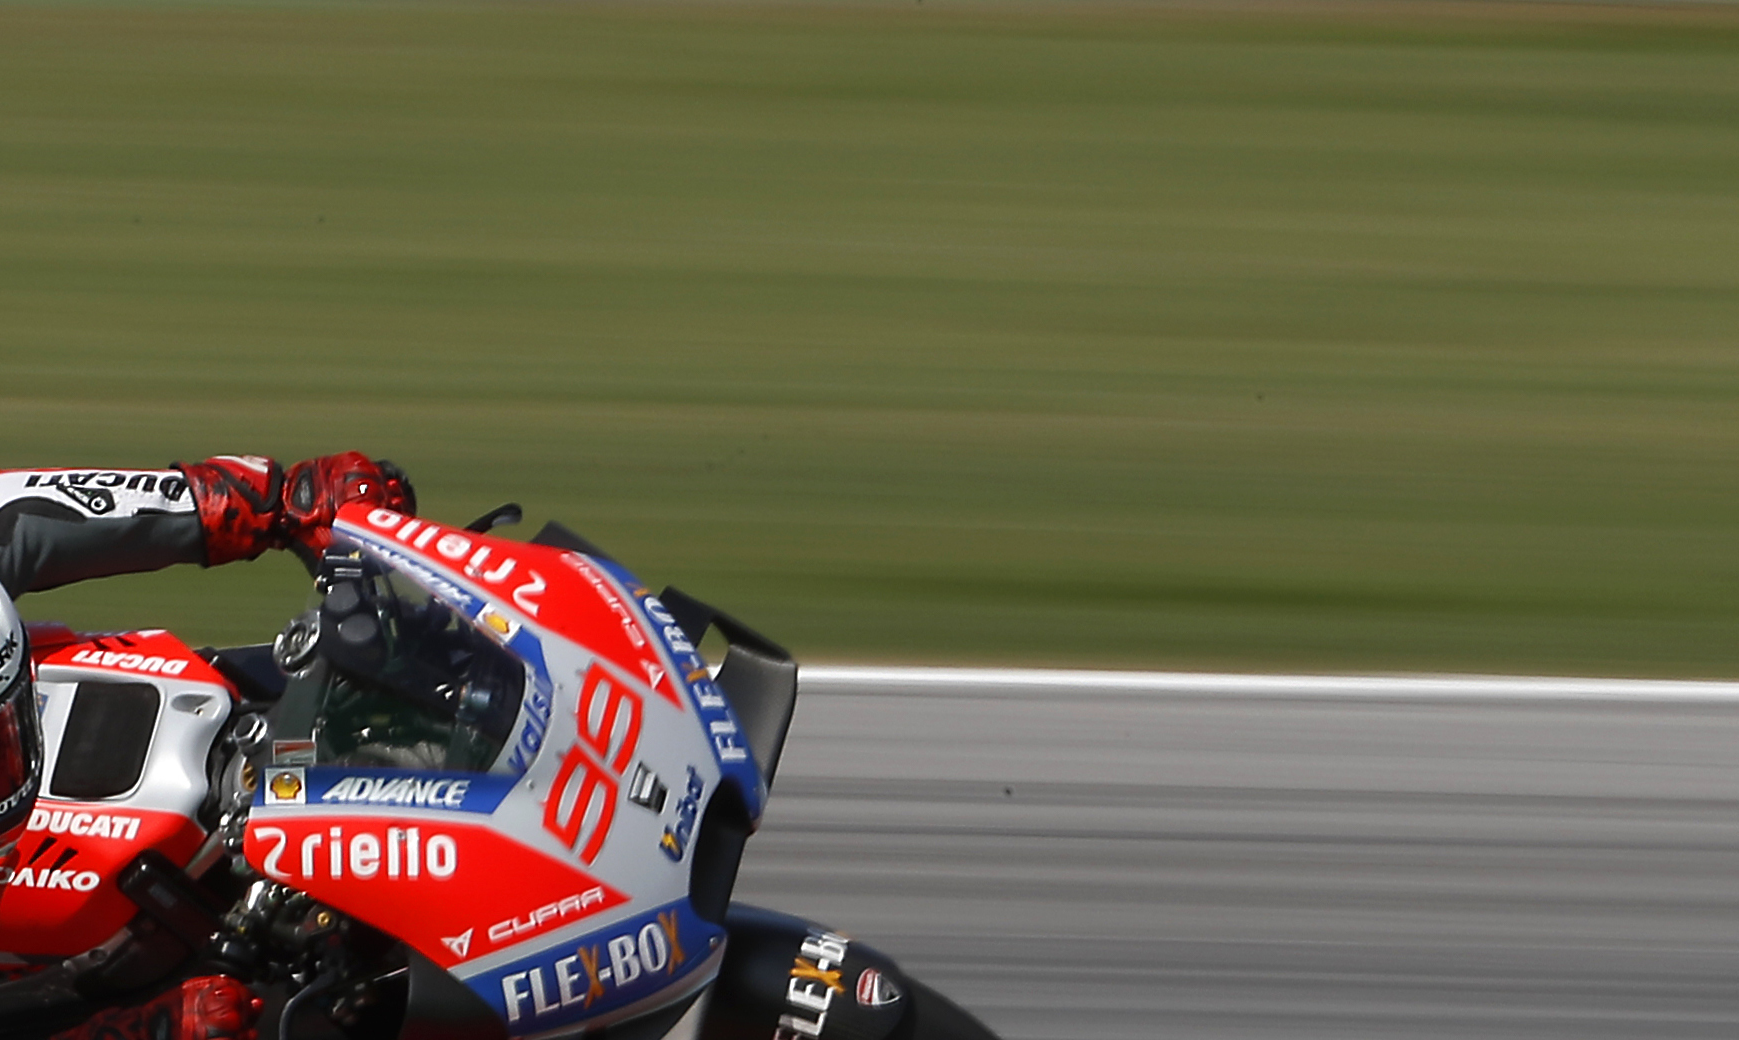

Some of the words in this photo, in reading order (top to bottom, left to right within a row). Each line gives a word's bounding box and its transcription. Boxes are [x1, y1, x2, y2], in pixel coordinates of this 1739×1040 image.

[366, 507, 519, 584] riello
[71, 649, 190, 675] DUCATI
[321, 777, 471, 807] ADVANCE
[26, 808, 142, 840] DUCATI
[301, 826, 458, 880] riello
[489, 886, 604, 942] CUPRA
[500, 910, 686, 1025] FLEX-BOX
